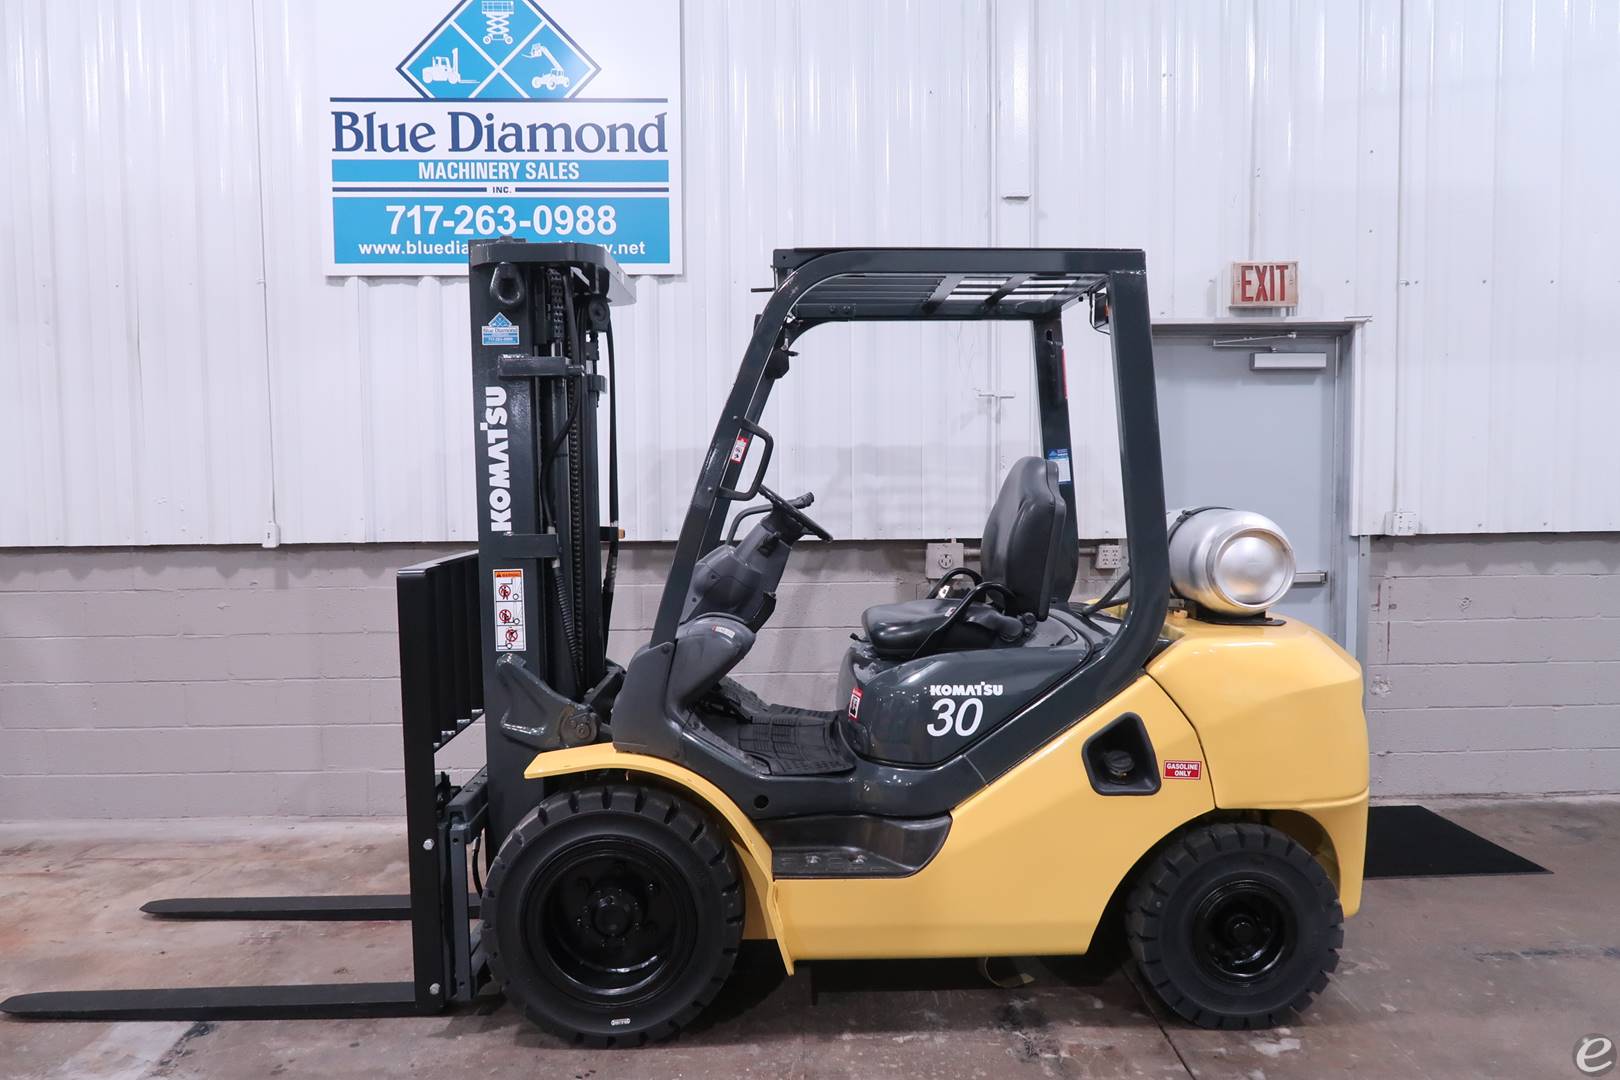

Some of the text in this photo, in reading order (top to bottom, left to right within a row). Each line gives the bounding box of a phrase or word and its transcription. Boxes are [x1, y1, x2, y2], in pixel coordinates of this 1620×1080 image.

[331, 111, 668, 153] Blue Diamond
[418, 161, 580, 180] MACHINERY SALES
[492, 186, 512, 194] INC.
[385, 204, 617, 236] 717-263-0988
[1241, 264, 1289, 302] EXIT
[480, 386, 512, 532] KOMATSU
[929, 681, 1004, 696] KOMATSU
[926, 697, 984, 737] 30
